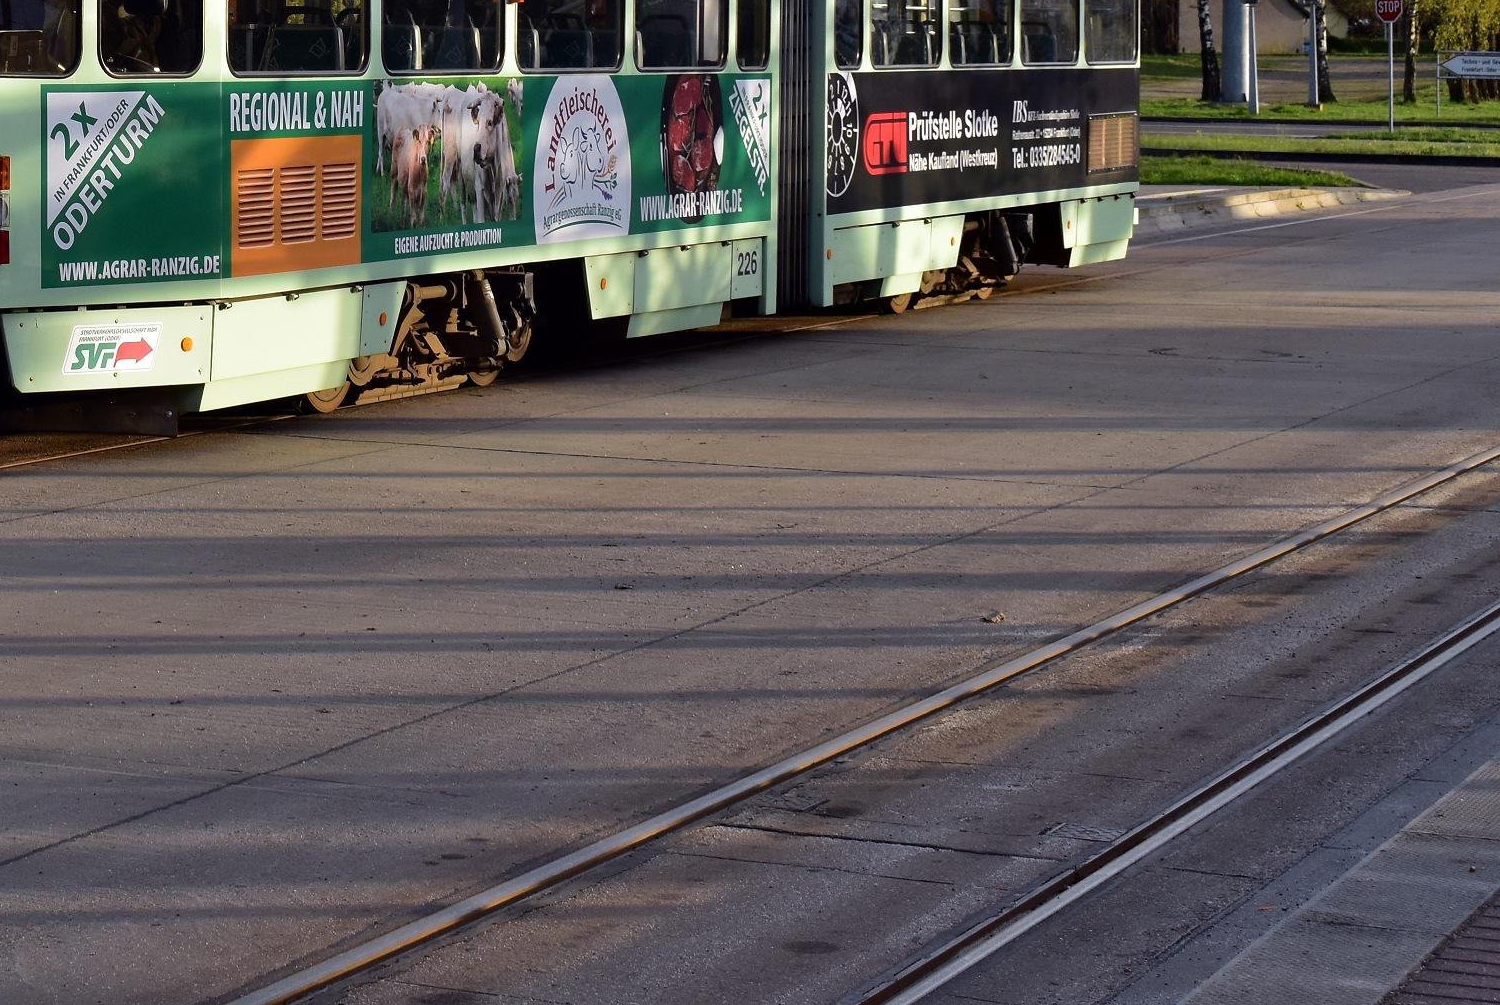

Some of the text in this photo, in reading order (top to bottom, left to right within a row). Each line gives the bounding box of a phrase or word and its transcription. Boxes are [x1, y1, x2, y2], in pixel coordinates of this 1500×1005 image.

[1377, 0, 1400, 14] STOP
[230, 90, 364, 132] REGIONAL & NAH
[908, 110, 963, 142] Prüfstelle
[964, 108, 998, 139] Slotke
[1012, 99, 1028, 123] IBS
[53, 98, 129, 203] IN FRANKFURT/ODER
[545, 87, 617, 194] Landfleischerei
[728, 84, 767, 197] ZIEGELSTR.
[53, 94, 166, 250] ODERTURM
[909, 147, 998, 173] Nähe Kaufland (Westkreuz)
[1012, 147, 1029, 169] Tel.:
[543, 202, 597, 230] Agrargenossenschaft
[597, 202, 615, 222] Ranzig
[640, 188, 743, 222] WWW.AGRAR-RANZIG.DE
[394, 227, 502, 255] EIGENE AUFZUCHT & PRODUKTION
[59, 255, 220, 282] WWW.AGRAR-RANZIG.DE
[737, 250, 758, 277] 226
[70, 342, 117, 371] SVF
